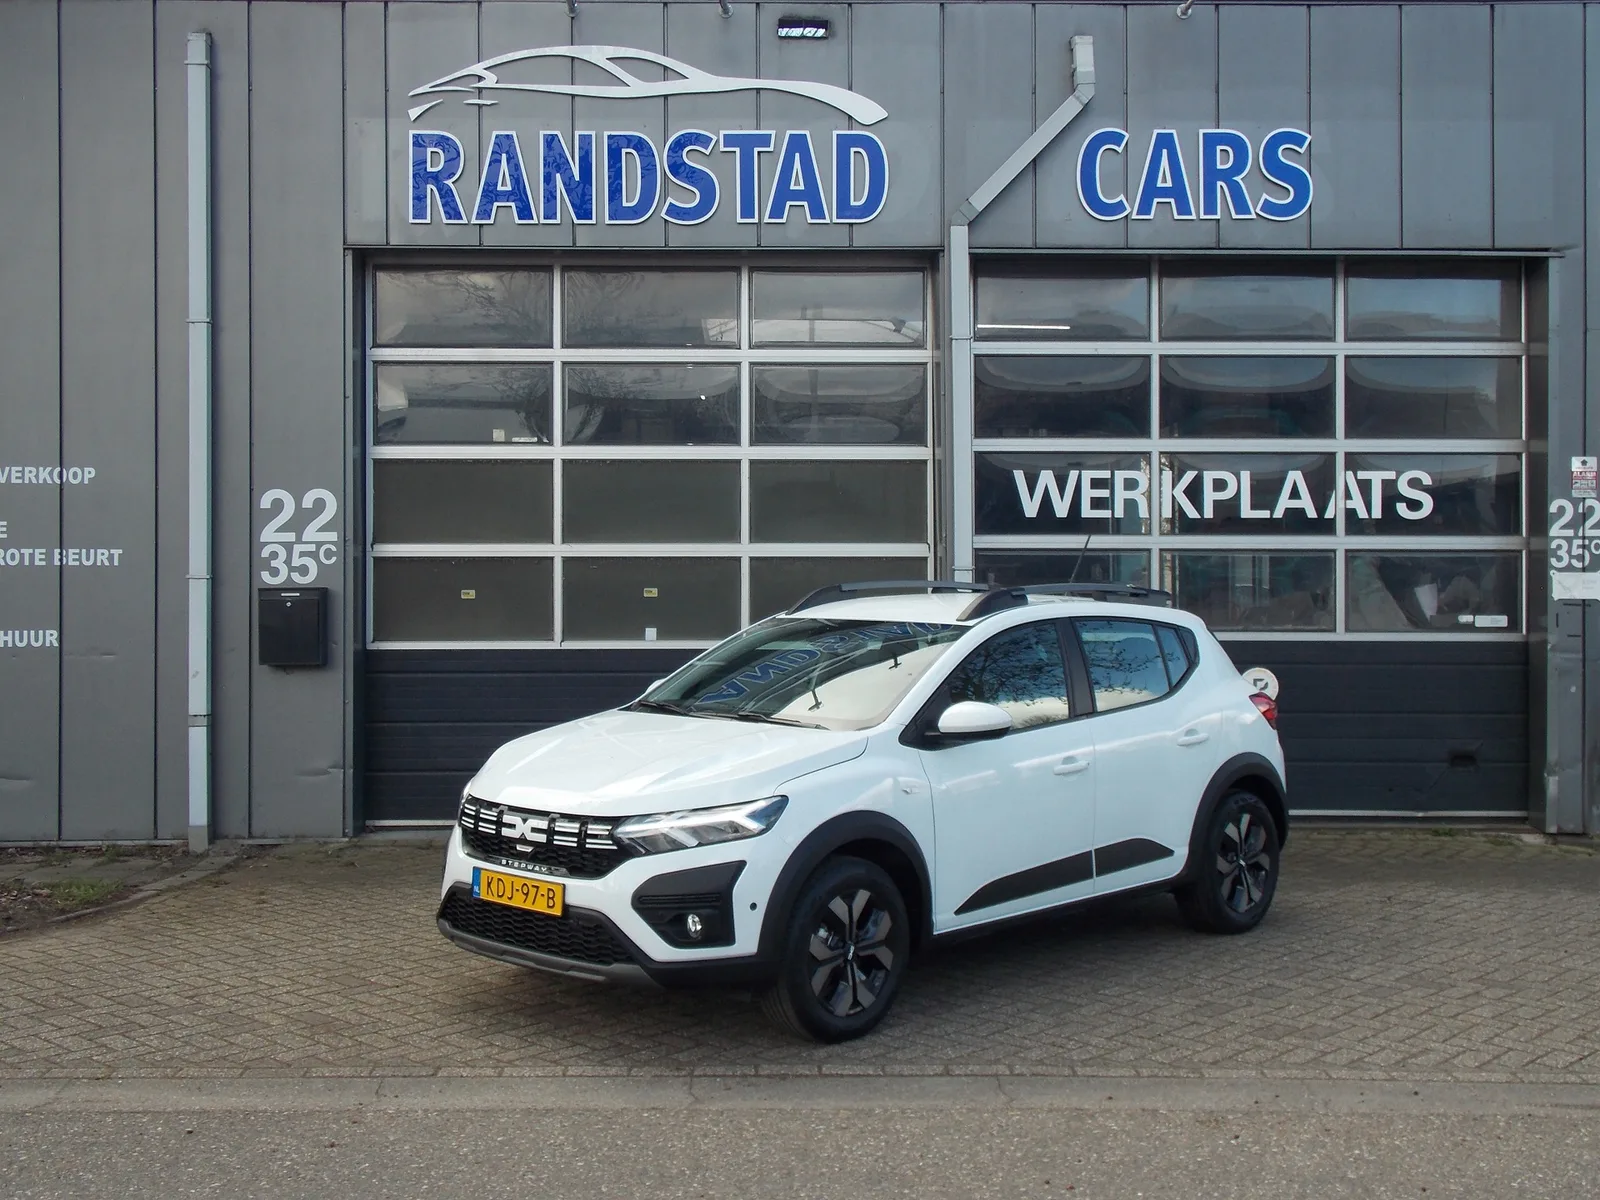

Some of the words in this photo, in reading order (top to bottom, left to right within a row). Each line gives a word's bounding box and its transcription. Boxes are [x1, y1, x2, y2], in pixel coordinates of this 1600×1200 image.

[408, 129, 889, 225] RANDSTAD
[1076, 127, 1313, 221] CARS
[0, 466, 96, 485] VERKOOP
[1013, 470, 1435, 520] WERKPLAATS
[260, 489, 337, 542] 22
[1549, 498, 1600, 537] 22
[54, 549, 122, 566] BEURT
[260, 544, 337, 585] 35C
[0, 630, 59, 647] HUUR
[501, 859, 547, 872] STEPWAY
[487, 875, 555, 908] KDJ-97-B
